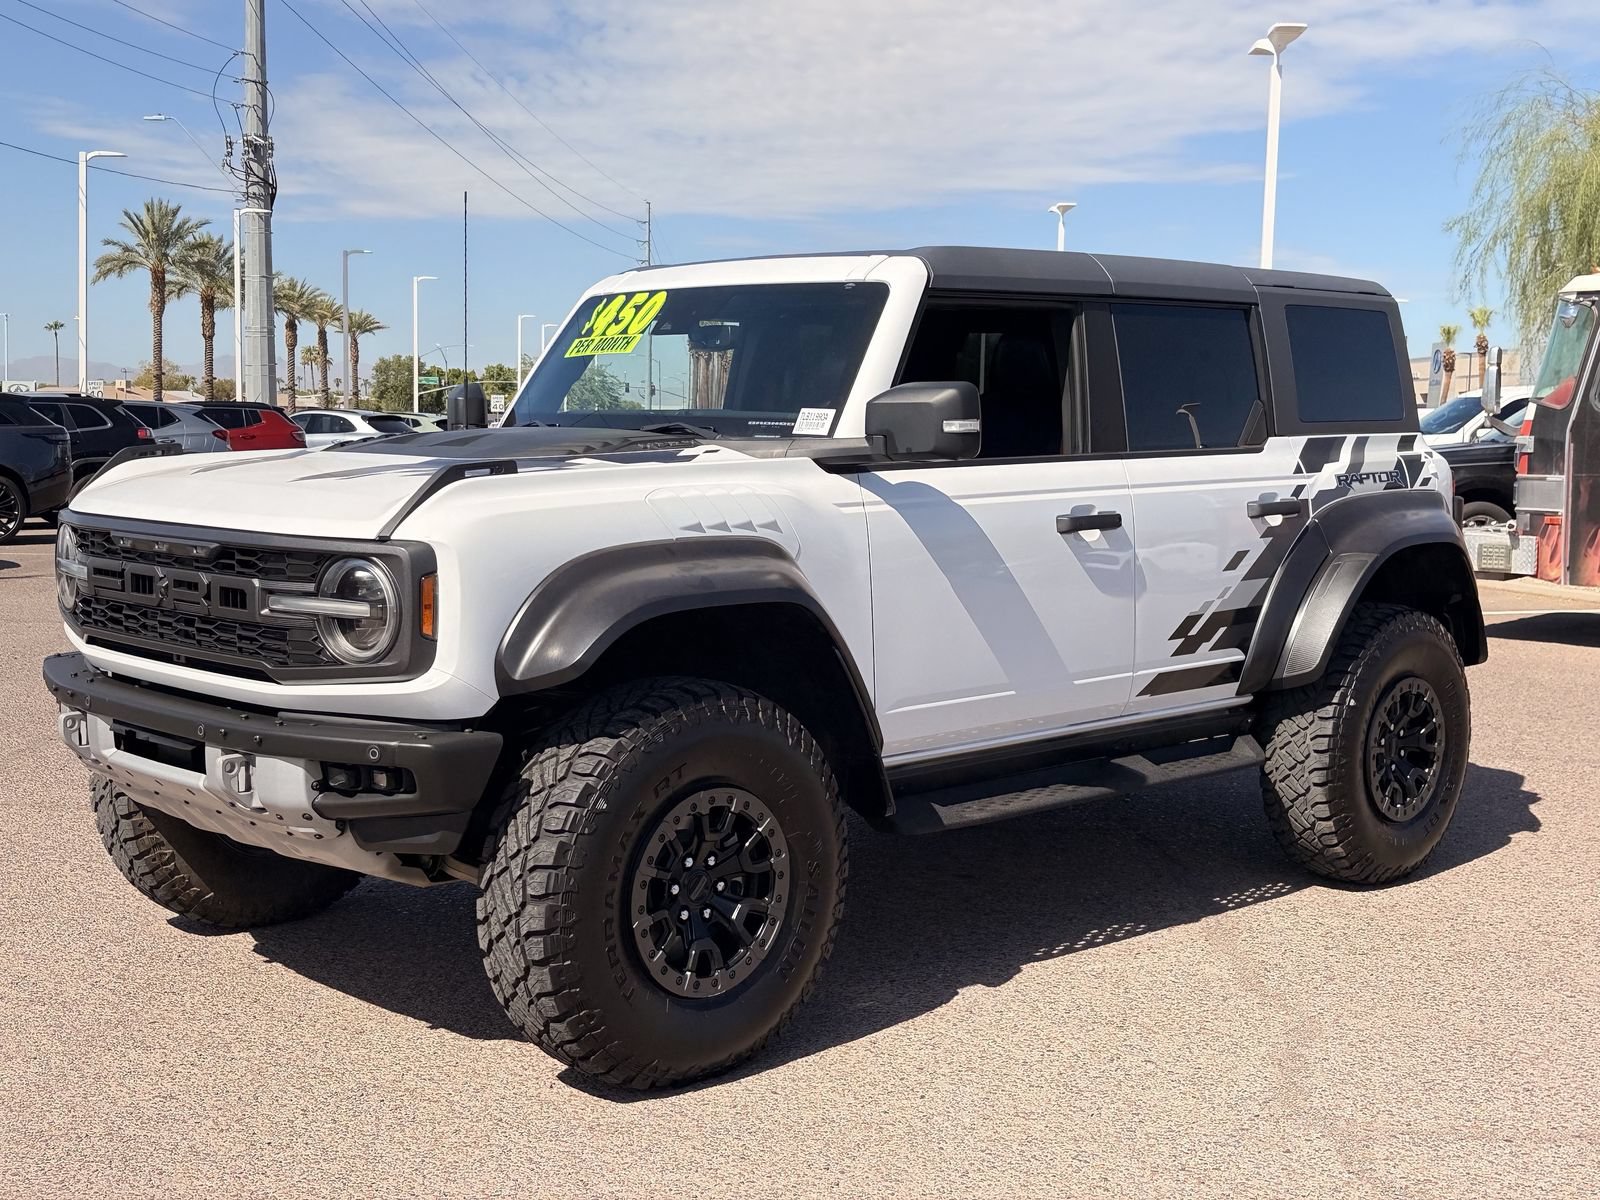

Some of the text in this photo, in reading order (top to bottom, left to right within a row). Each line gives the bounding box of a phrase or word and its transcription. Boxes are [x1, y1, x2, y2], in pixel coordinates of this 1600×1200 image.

[582, 291, 667, 336] $450
[569, 336, 636, 356] PER MONTH
[492, 403, 504, 411] 40
[1335, 470, 1405, 491] RAPTOR
[87, 556, 260, 622] FORD
